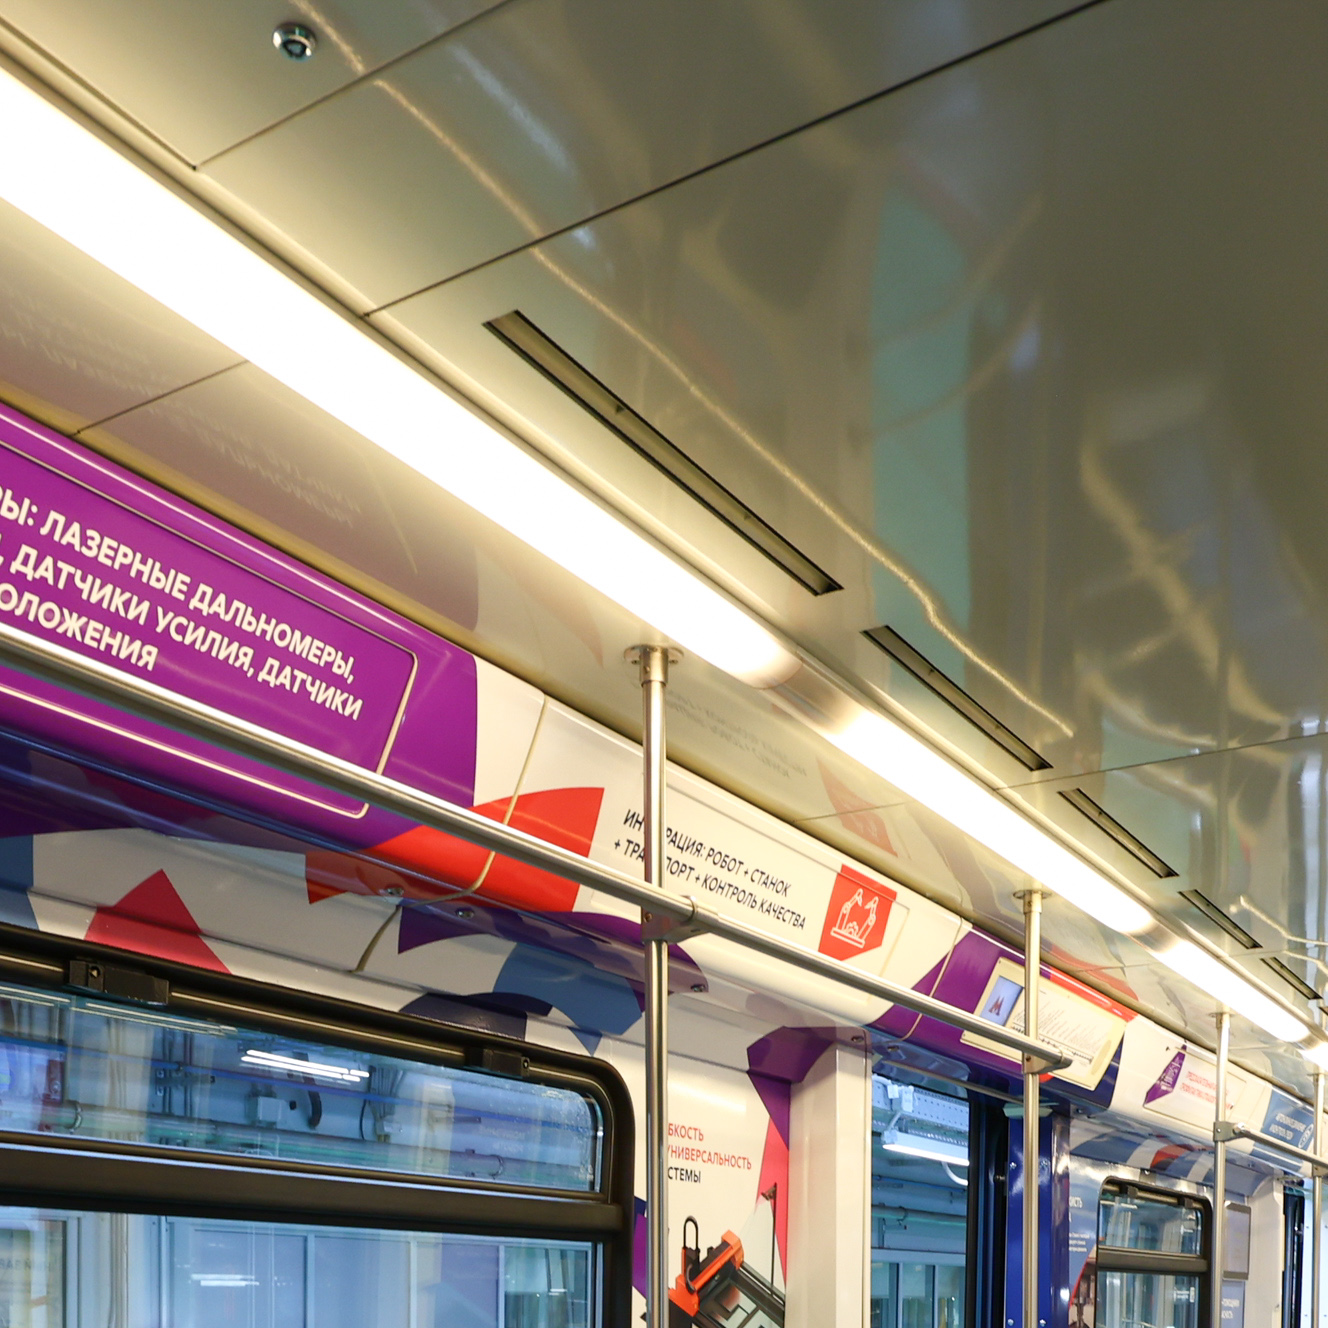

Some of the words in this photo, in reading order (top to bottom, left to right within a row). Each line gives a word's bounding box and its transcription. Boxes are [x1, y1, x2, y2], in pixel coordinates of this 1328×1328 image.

[9, 543, 150, 626] ДАТЧИКИ
[155, 606, 256, 678] УСИЛИЯ,
[257, 657, 363, 721] ДАТЧИКИ
[39, 510, 189, 601] ЛАЗЕРНЫЕ
[188, 583, 356, 684] ДАЛЬНОМЕРЫ,
[622, 808, 707, 858] ИНРАЦИЯ:
[705, 847, 744, 877] РОБОТ
[750, 868, 791, 898] СТАНОК
[701, 872, 758, 910] КОНТРОЛЬ
[758, 899, 807, 930] КАЧЕСТВА
